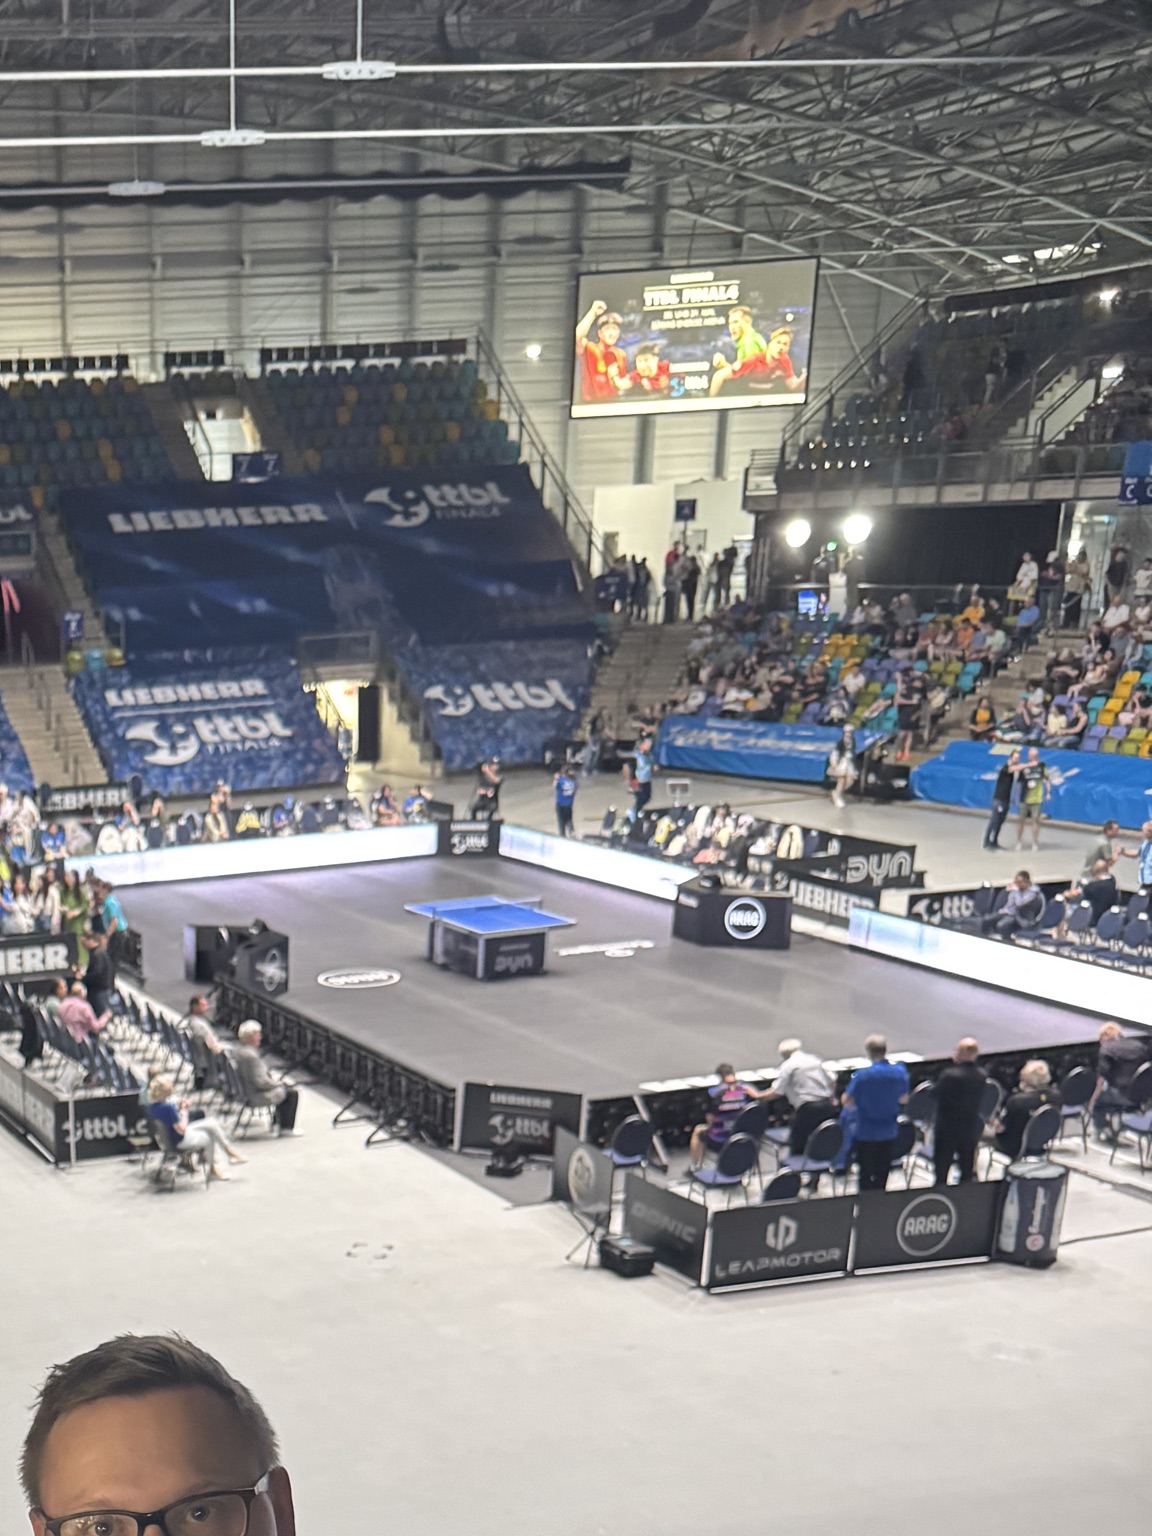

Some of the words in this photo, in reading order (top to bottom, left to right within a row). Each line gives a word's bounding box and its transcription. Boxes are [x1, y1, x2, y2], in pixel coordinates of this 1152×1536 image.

[423, 481, 511, 507] ttbl
[107, 502, 329, 534] LIEBHERR
[104, 677, 268, 707] LIEBHERR
[471, 680, 576, 712] ttbl
[192, 711, 294, 742] ttbl
[903, 1213, 950, 1236] ARAG
[714, 1247, 843, 1277] LEAPMOTOR
